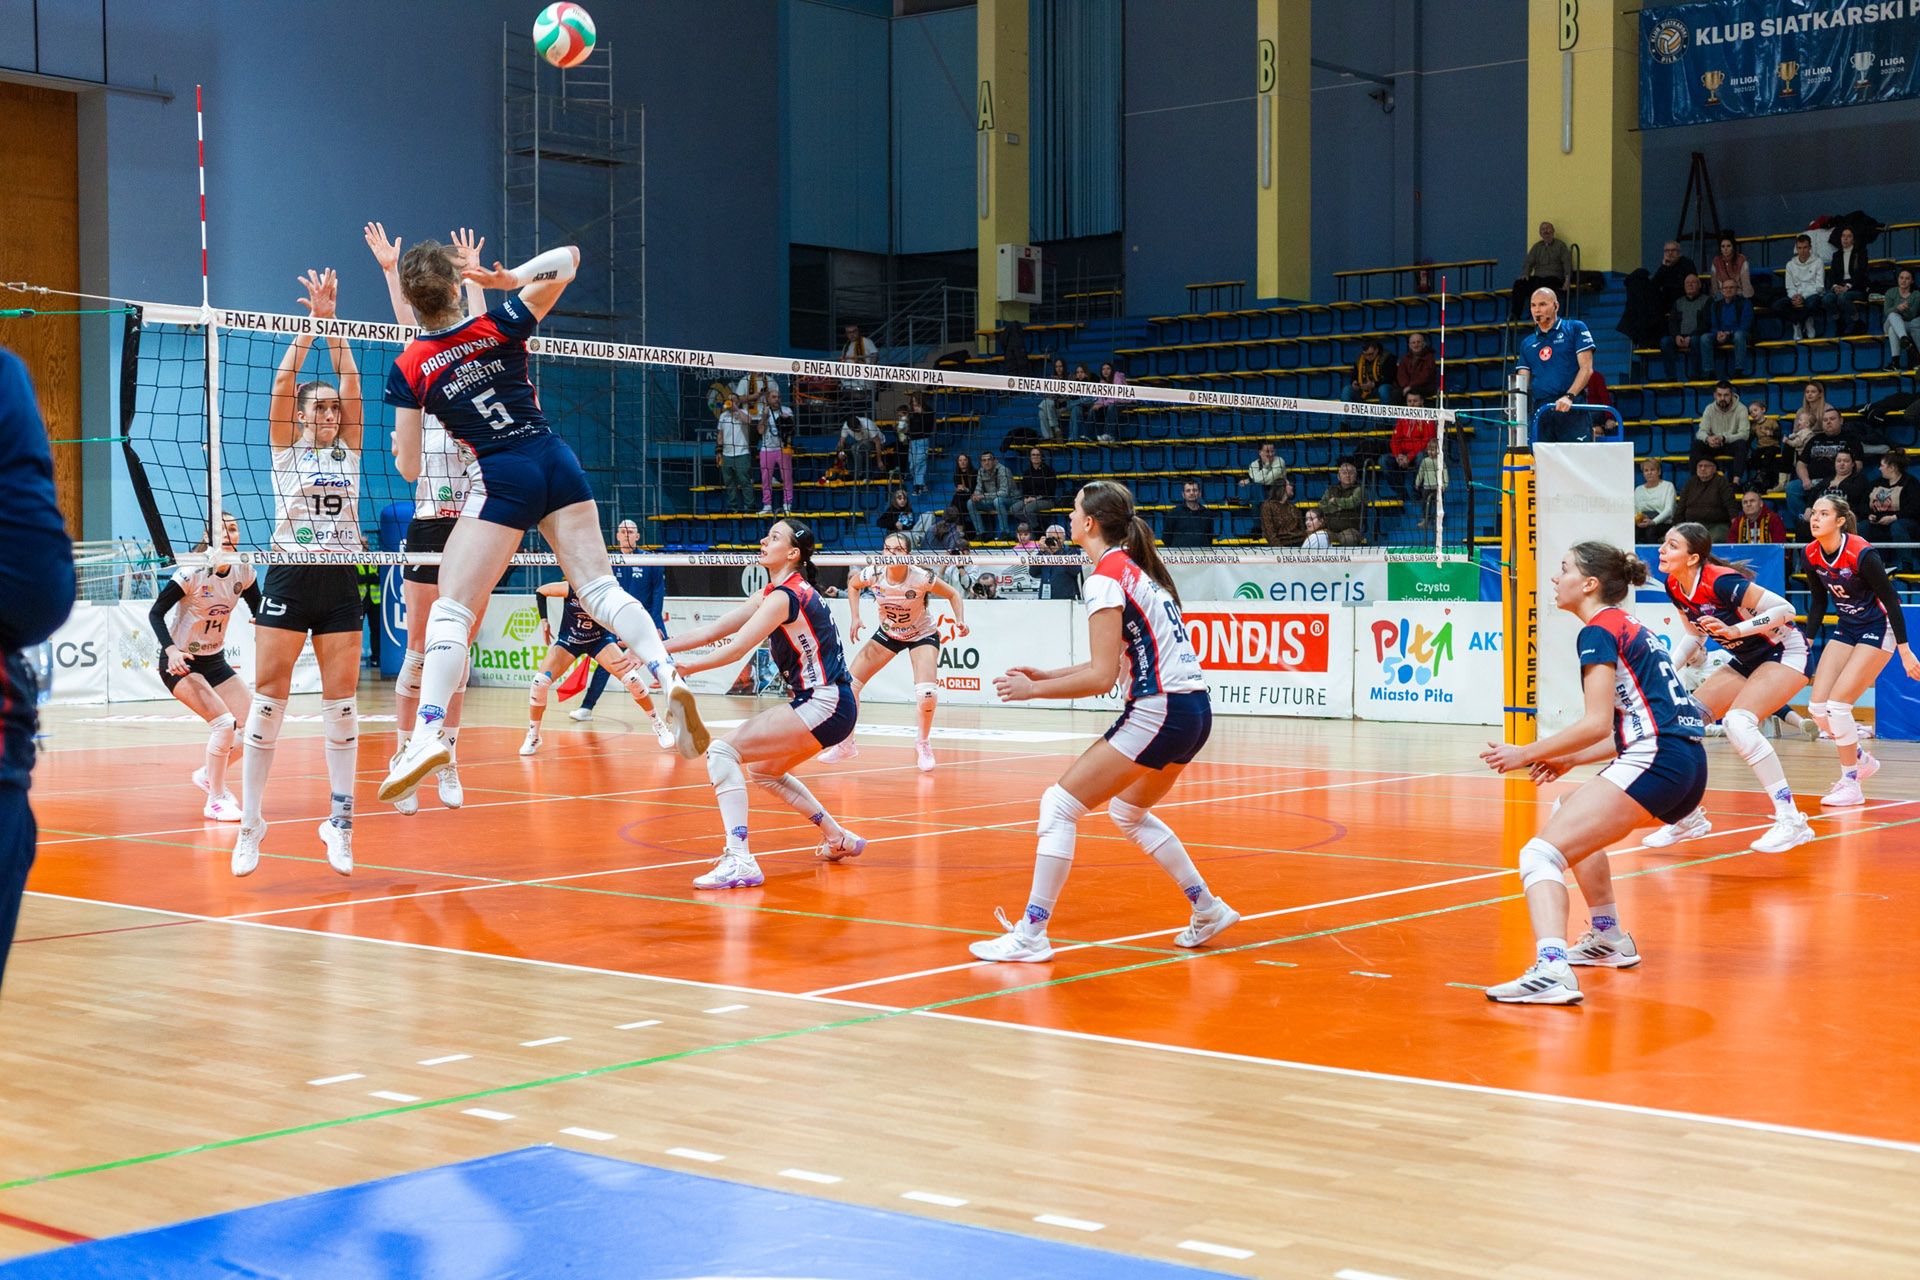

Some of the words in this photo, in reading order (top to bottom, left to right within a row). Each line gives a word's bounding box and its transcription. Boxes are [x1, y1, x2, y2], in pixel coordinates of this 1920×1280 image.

[1696, 21, 1755, 46] KLUB
[1760, 1, 1904, 38] SIATKARSKI
[1258, 39, 1276, 94] B
[1885, 56, 1906, 66] LIGA
[1740, 75, 1759, 86] LIGA
[1811, 66, 1833, 76] LIGA
[978, 80, 994, 131] A
[225, 311, 266, 329] ENEA
[272, 315, 311, 333] KLUB
[316, 319, 400, 341] SIATKARSKI
[405, 327, 421, 341] PI
[545, 339, 578, 355] ENEA
[582, 342, 614, 358] KLUB
[618, 346, 687, 365] SIATKARSKI
[690, 352, 715, 367] PIŁA
[454, 359, 482, 378] ENEA
[804, 361, 832, 376] ENEA
[835, 364, 861, 378] KLUB
[864, 366, 920, 382] SIATKARSKI
[923, 370, 943, 384] PIŁA
[442, 359, 506, 400] ENERGETYK
[1018, 378, 1041, 391] ENEA
[1044, 380, 1066, 393] KLUB
[1068, 382, 1116, 397] SIATKARSKI
[1117, 385, 1136, 398] PIŁA
[471, 388, 514, 430] 5
[1198, 392, 1218, 405] ENEA
[1220, 393, 1238, 406] KLUB
[1240, 395, 1281, 409] SIATKARSKI
[1282, 398, 1298, 410] PIŁA
[1351, 403, 1368, 415] ENEA
[1370, 405, 1386, 417] KLUB
[1387, 406, 1423, 419] SIATKARSKI
[1424, 409, 1438, 420] PIŁA
[312, 494, 343, 516] 19
[316, 524, 354, 541] eneris
[254, 552, 283, 564] ENEA
[288, 552, 317, 564] KLUB
[320, 552, 382, 564] SIATKARSKI
[385, 552, 409, 564] PIŁA
[523, 553, 548, 565] KLUB
[698, 555, 721, 566] ENEA
[722, 555, 745, 566] KLUB
[874, 556, 895, 566] ENEA
[896, 556, 914, 566] KLUB
[915, 556, 957, 566] SIATKARSKI
[958, 556, 974, 566] PIŁA
[1028, 556, 1045, 565] ENEA
[1046, 556, 1064, 565] KLUB
[1064, 556, 1093, 565] SIATKAR
[1163, 556, 1179, 564] ENEA
[1180, 556, 1194, 564] KLUB
[1195, 556, 1227, 564] SIATKARSKI
[1282, 555, 1297, 563] ENEA
[1297, 555, 1310, 563] KLUB
[1310, 555, 1339, 563] SIATKARSKI
[1270, 572, 1365, 601] eneris
[1415, 582, 1450, 594] Czysta
[1827, 583, 1851, 599] 12
[204, 619, 222, 634] 14
[1187, 619, 1306, 666] ONDIS
[57, 641, 98, 668] CS
[470, 641, 549, 671] lanetH
[939, 648, 979, 669] ALO
[1383, 656, 1431, 686] 500
[949, 678, 979, 689] ORLEN
[1658, 661, 1690, 706] 2
[1220, 685, 1251, 704] THE
[1259, 686, 1327, 706] FUTURE
[1370, 687, 1419, 702] Miasto
[1424, 688, 1453, 703] Piła
